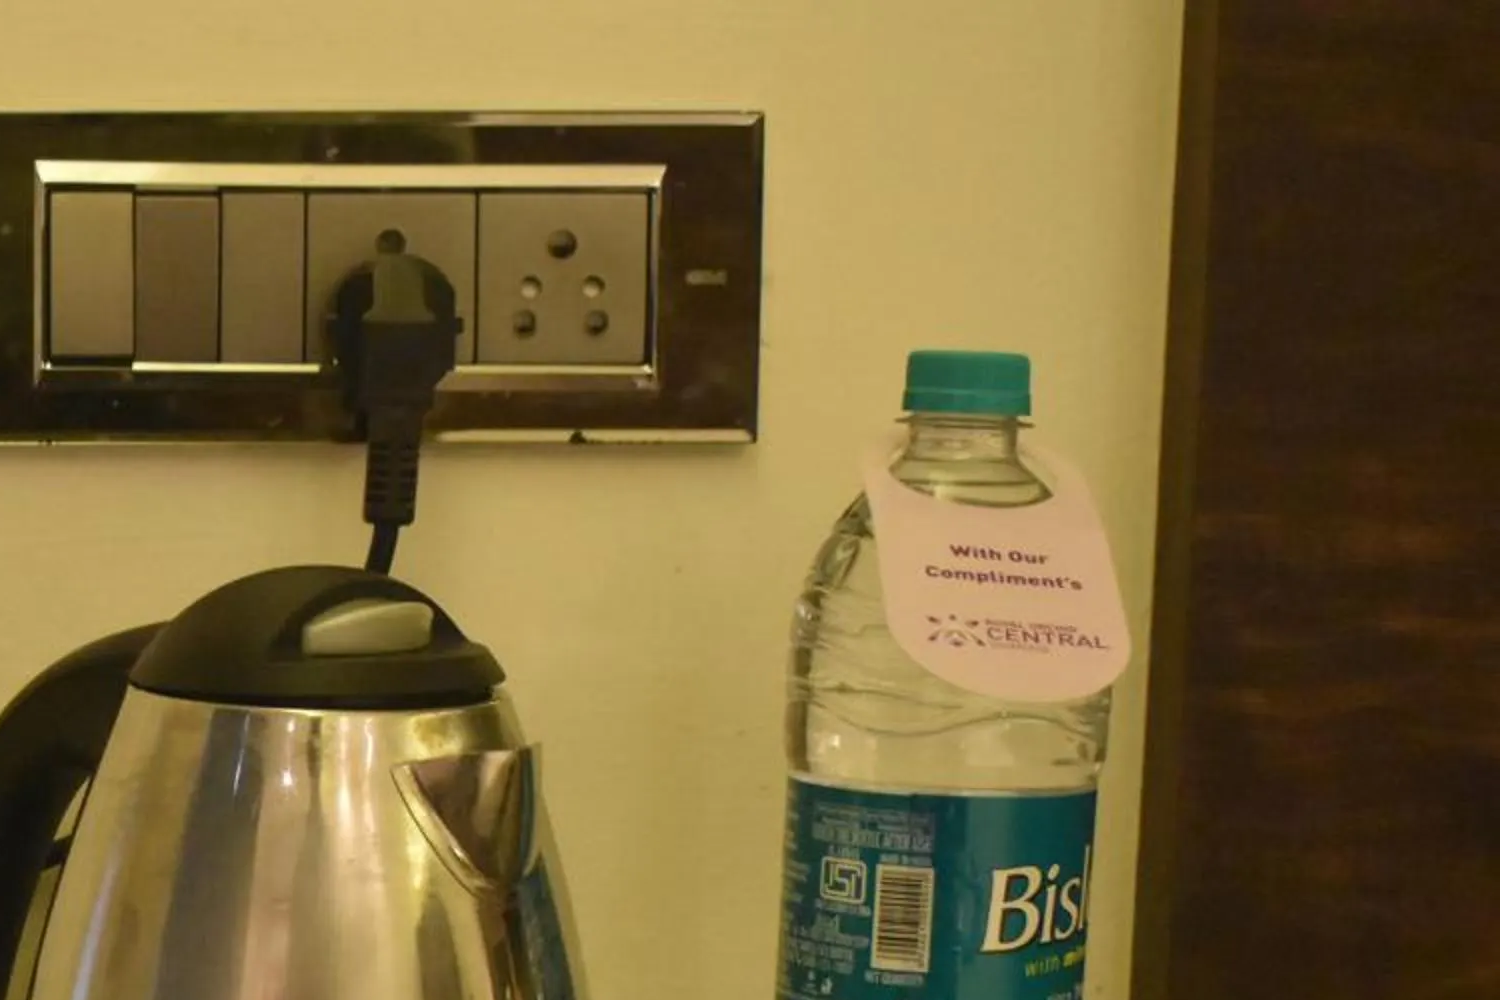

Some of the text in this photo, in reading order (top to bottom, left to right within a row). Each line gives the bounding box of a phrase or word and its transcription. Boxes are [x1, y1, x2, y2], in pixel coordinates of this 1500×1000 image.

[949, 543, 1050, 566] With Our
[924, 564, 1084, 591] Compliment's
[986, 625, 1111, 650] CENTRAL
